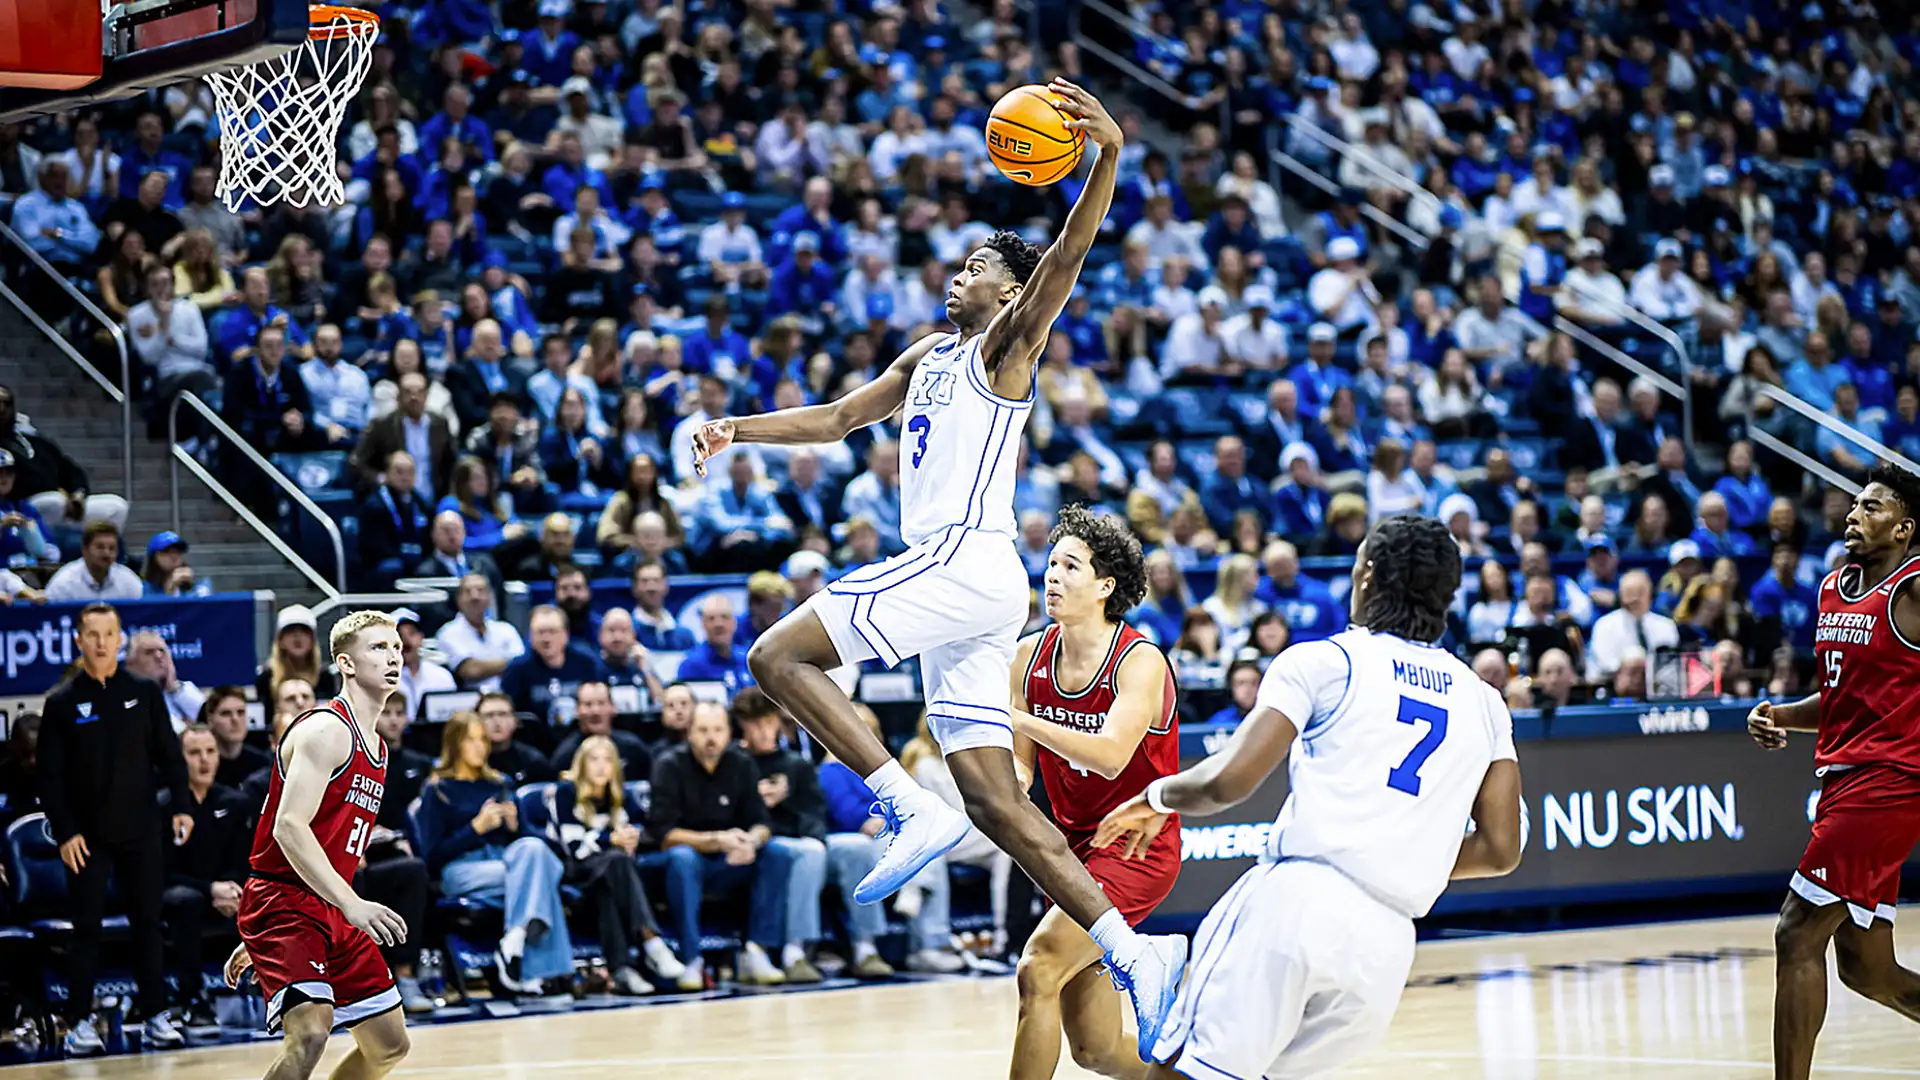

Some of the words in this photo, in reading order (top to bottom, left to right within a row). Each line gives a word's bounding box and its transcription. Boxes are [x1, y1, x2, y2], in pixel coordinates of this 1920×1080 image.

[989, 129, 1033, 156] ELITE
[908, 414, 931, 469] 3
[1818, 612, 1877, 630] EASTERN
[1393, 659, 1452, 695] MBOUP
[1824, 650, 1843, 688] 15
[1387, 694, 1448, 797] 7
[345, 816, 370, 858] 21
[1544, 789, 1619, 851] NU
